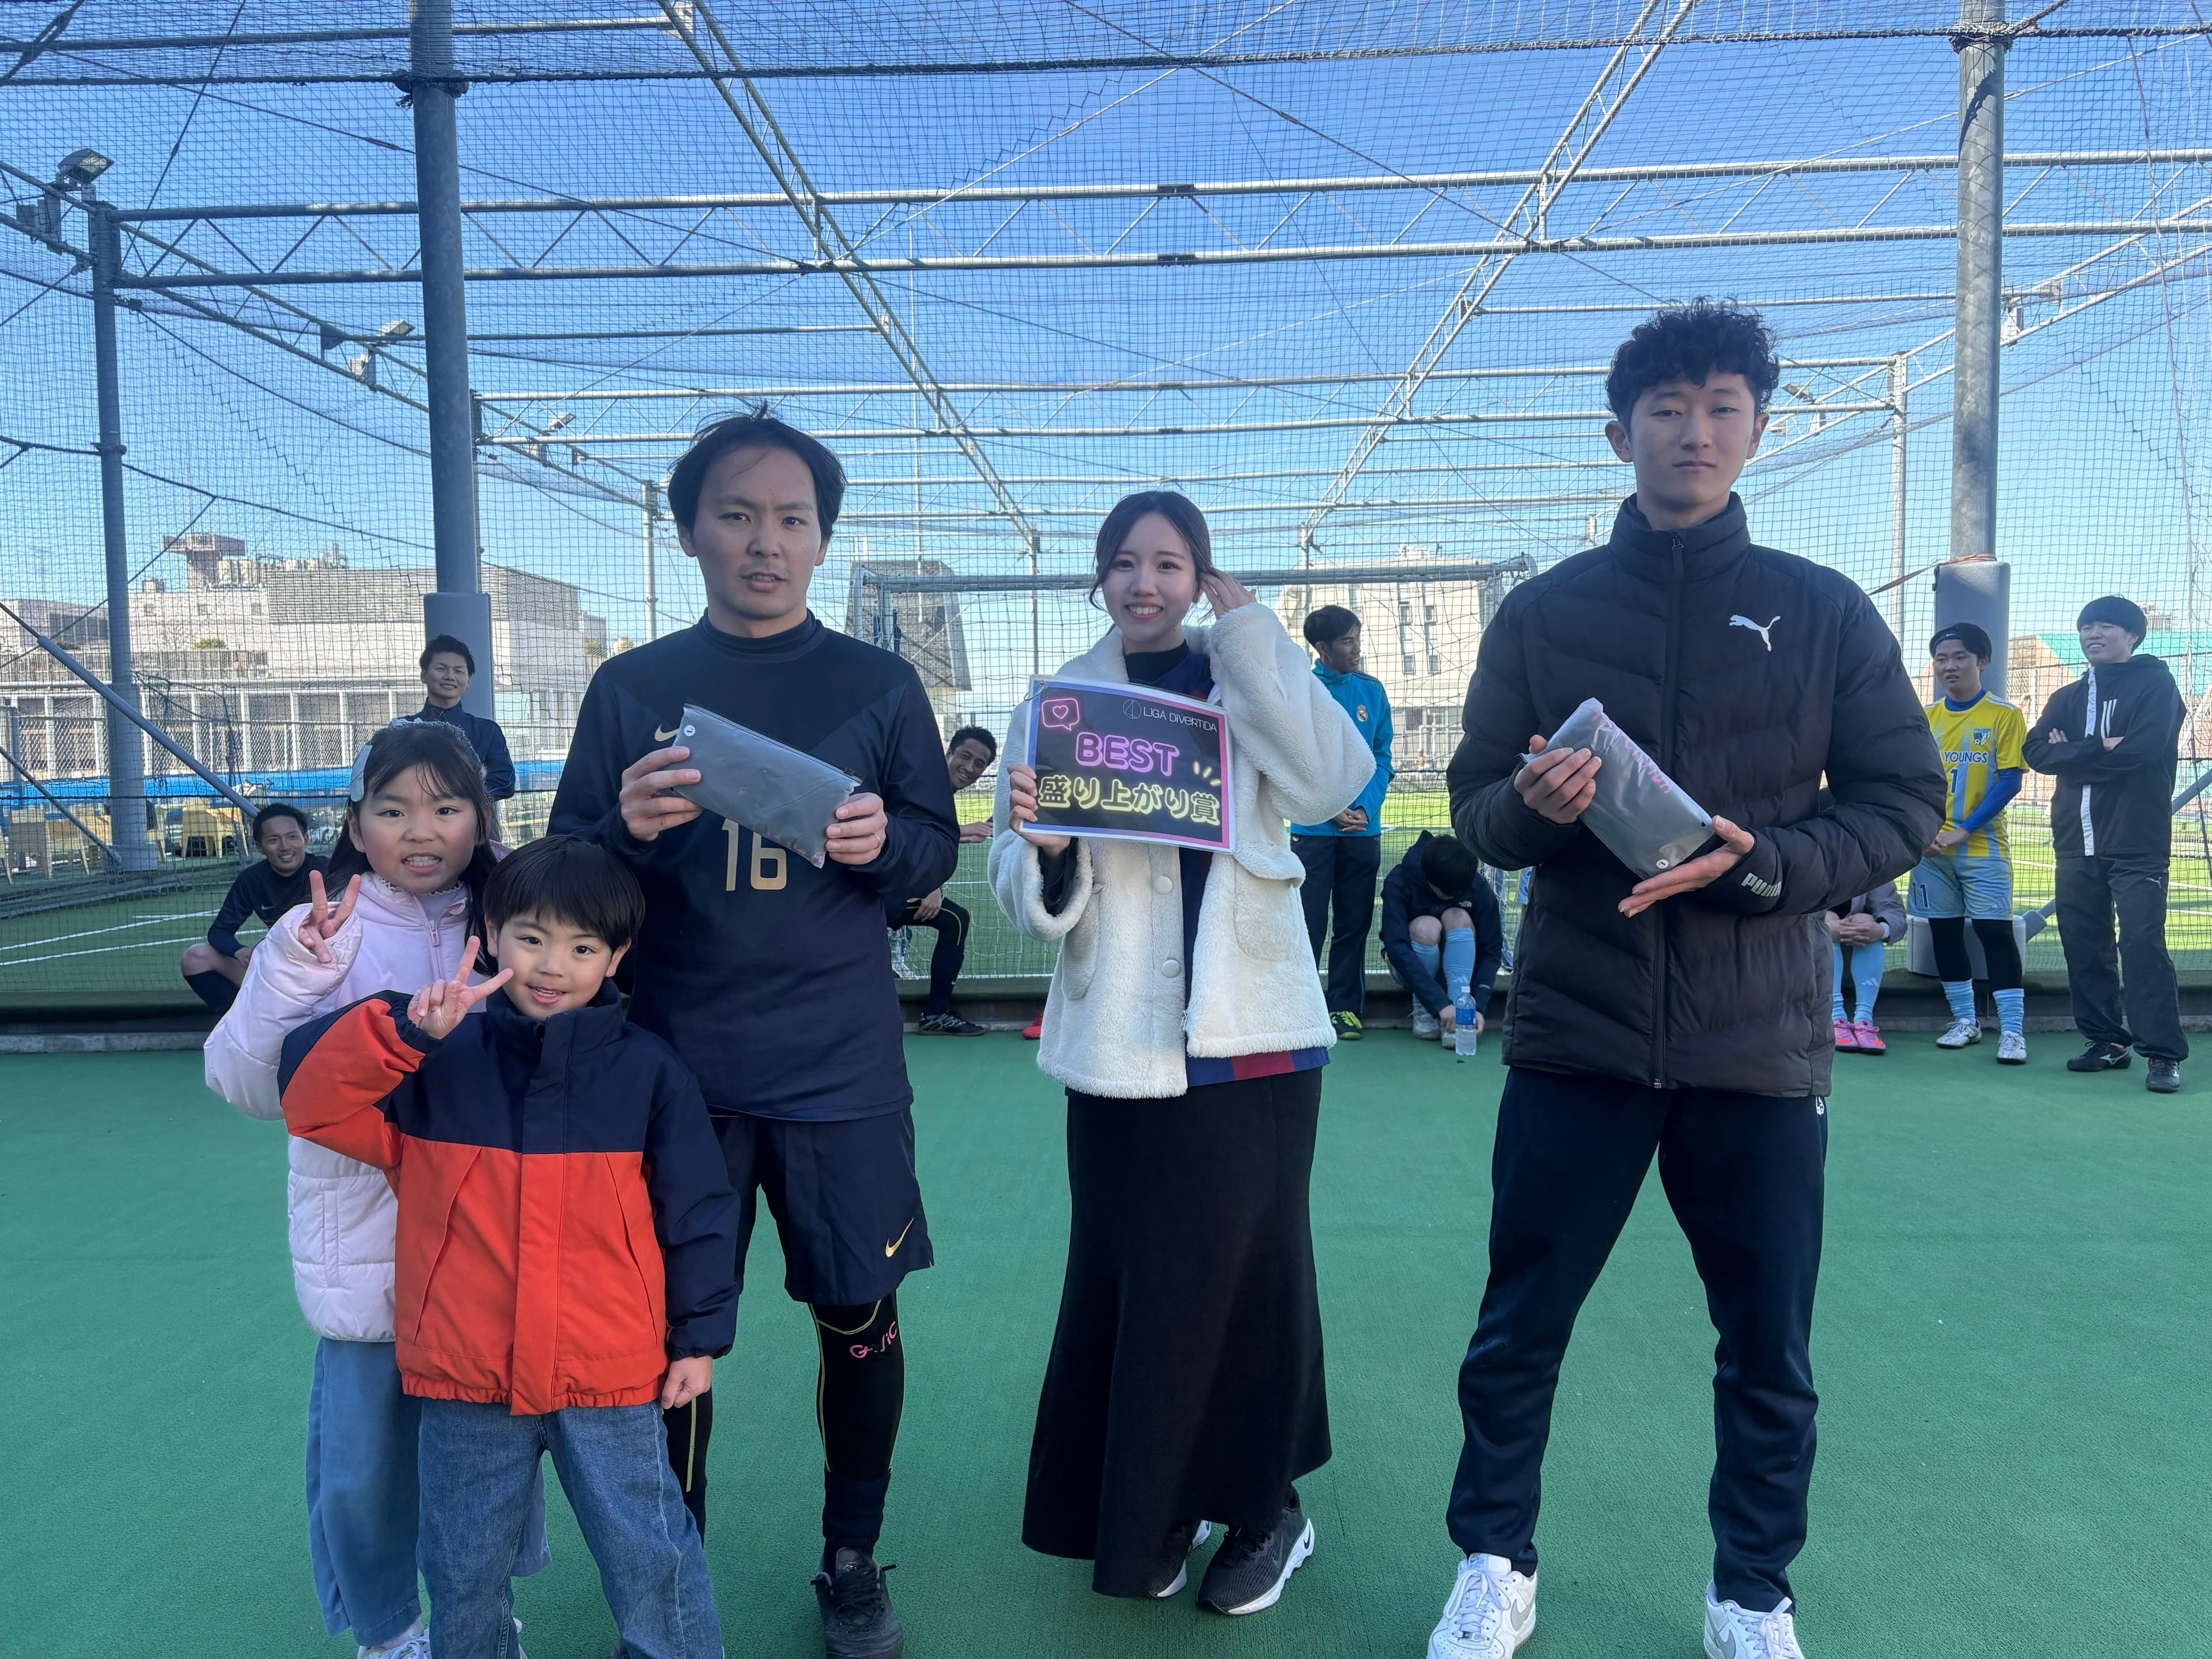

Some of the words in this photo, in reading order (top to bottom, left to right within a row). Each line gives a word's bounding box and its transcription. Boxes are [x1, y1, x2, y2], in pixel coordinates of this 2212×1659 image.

[1075, 732, 1180, 777] BEST
[1944, 751, 1988, 764] YOUNGS
[1038, 774, 1220, 826] 盛り上がり賞
[722, 818, 787, 891] 16
[1741, 872, 1782, 897] PUMA
[1912, 882, 1929, 908] 11
